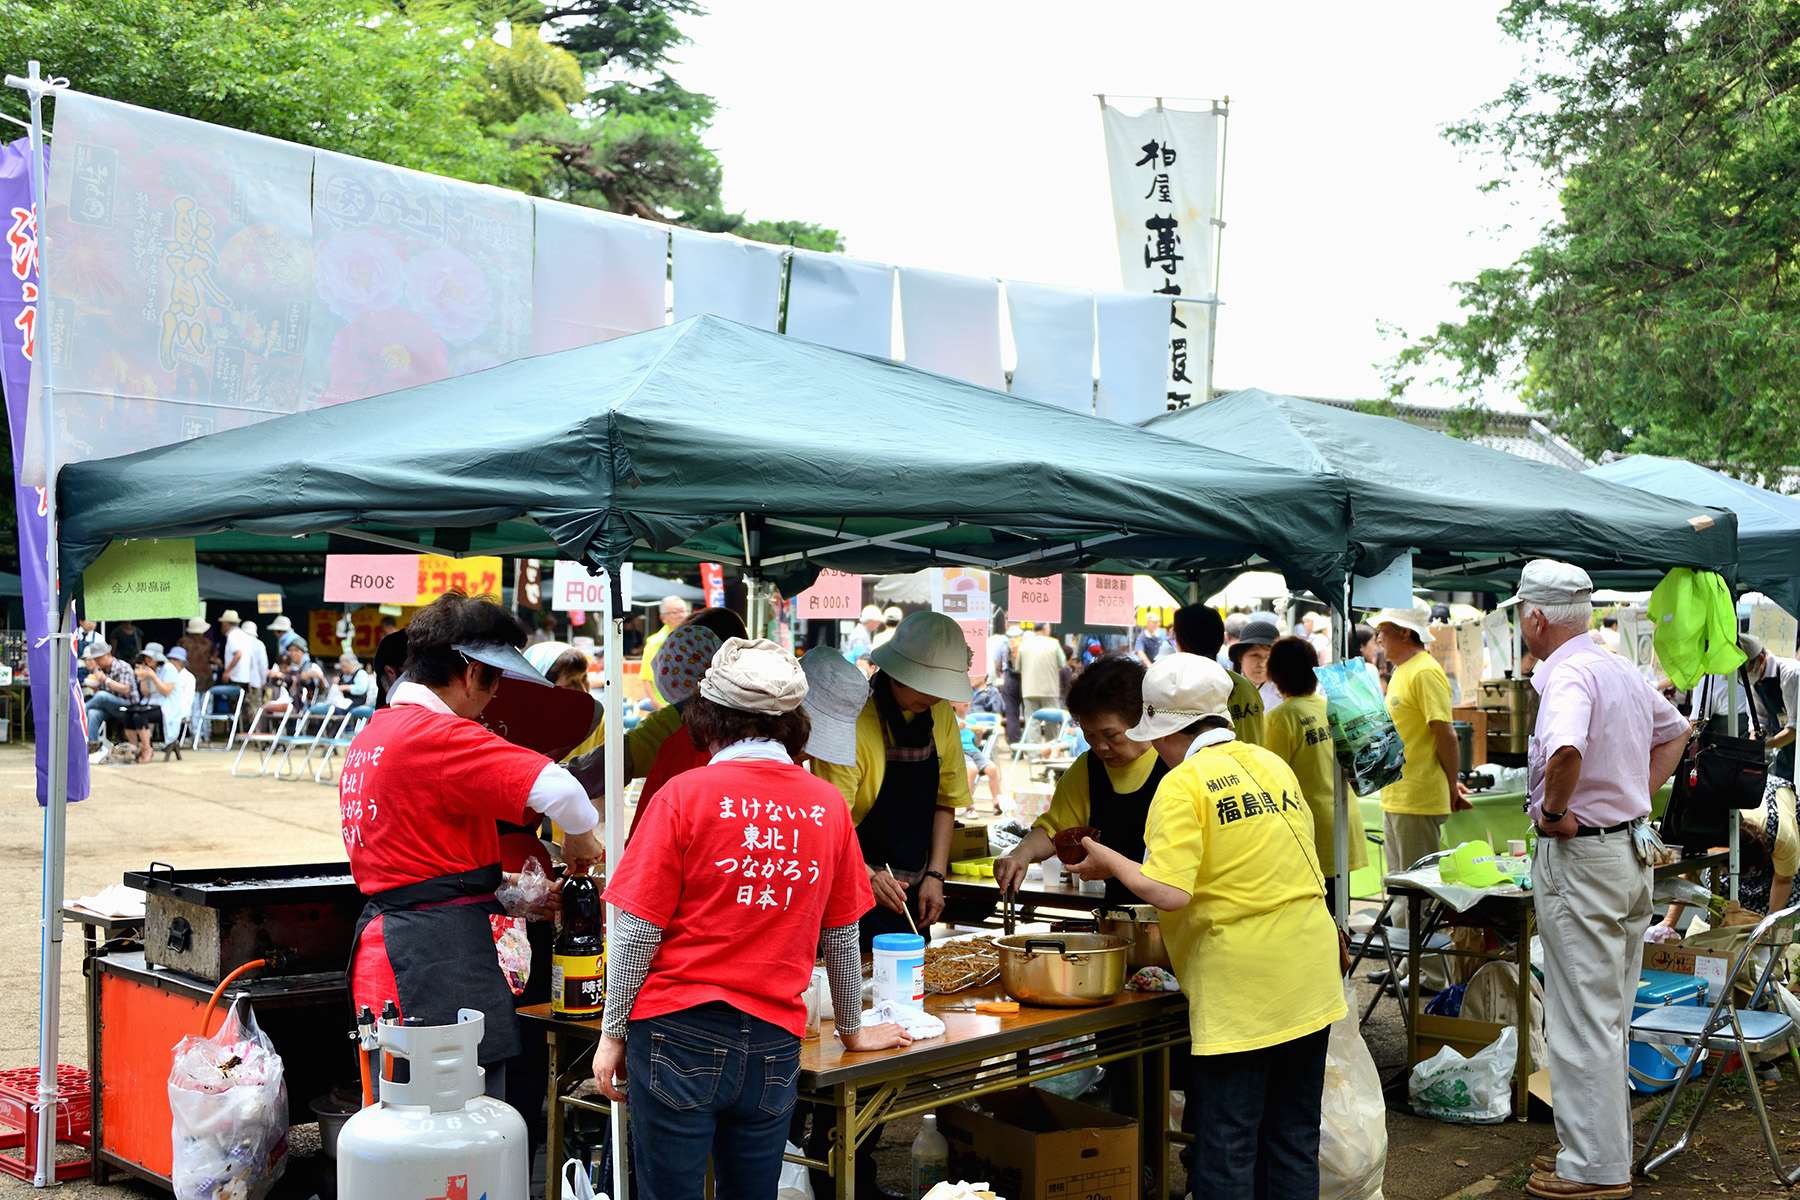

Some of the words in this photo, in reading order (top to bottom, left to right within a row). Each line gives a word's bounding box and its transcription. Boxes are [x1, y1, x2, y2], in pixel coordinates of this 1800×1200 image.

[1205, 774, 1241, 793] 桶川市
[719, 796, 826, 827] まけないぞ
[740, 822, 799, 854] 東北！
[715, 854, 820, 884] つながろう
[736, 883, 793, 911] 日本！
